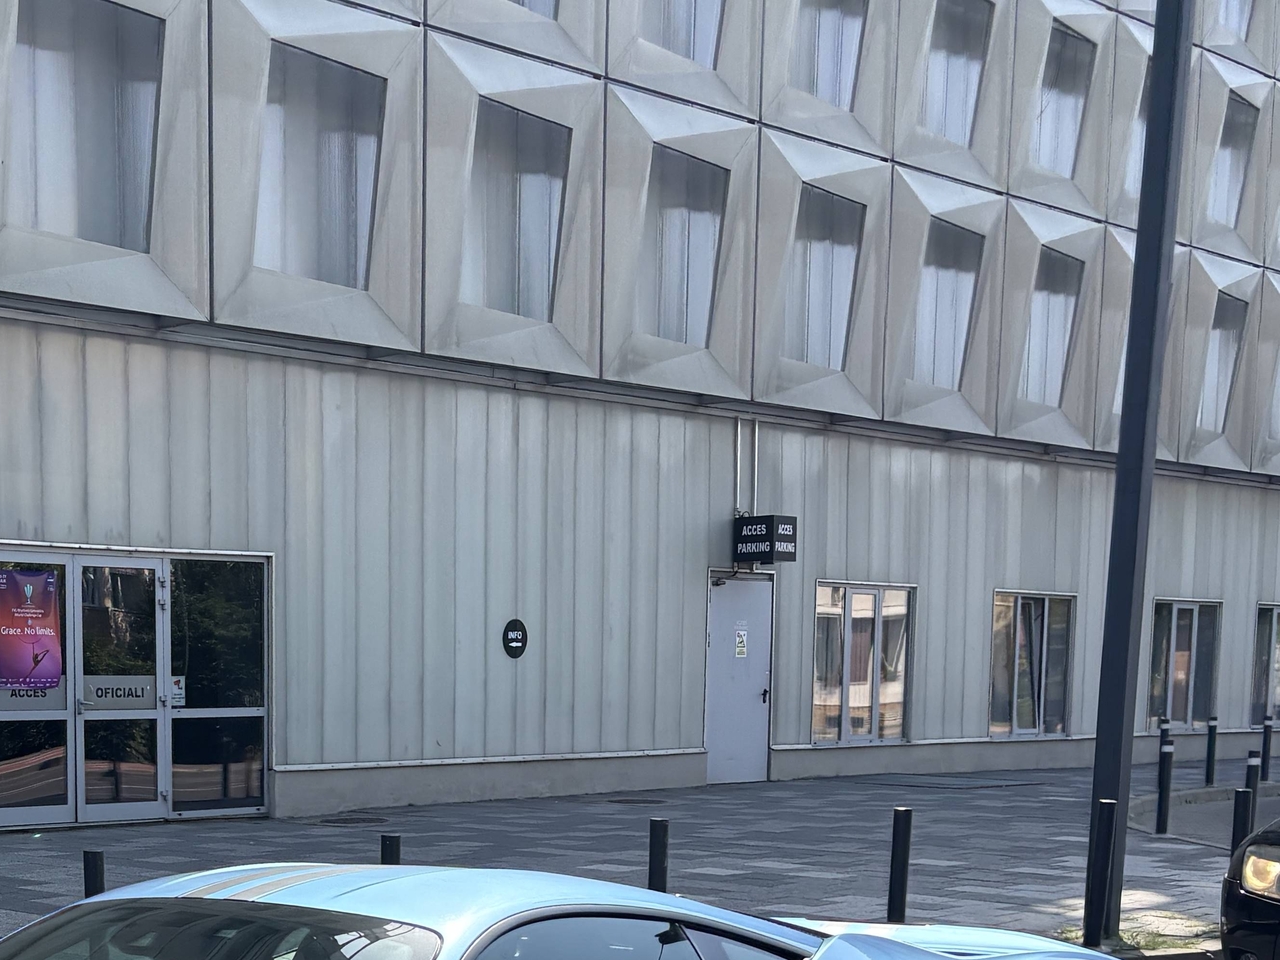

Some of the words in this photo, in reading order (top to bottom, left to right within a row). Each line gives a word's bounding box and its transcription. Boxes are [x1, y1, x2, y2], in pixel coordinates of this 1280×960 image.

[741, 524, 767, 536] ACCES
[778, 524, 793, 535] ACCES
[737, 541, 770, 553] PARKING
[774, 541, 795, 553] PARKING
[0, 626, 23, 635] Grace.
[24, 626, 35, 635] No
[36, 626, 55, 636] limits.
[508, 631, 522, 639] INFO
[10, 689, 47, 698] ACCES
[95, 687, 145, 699] OFICIALI
